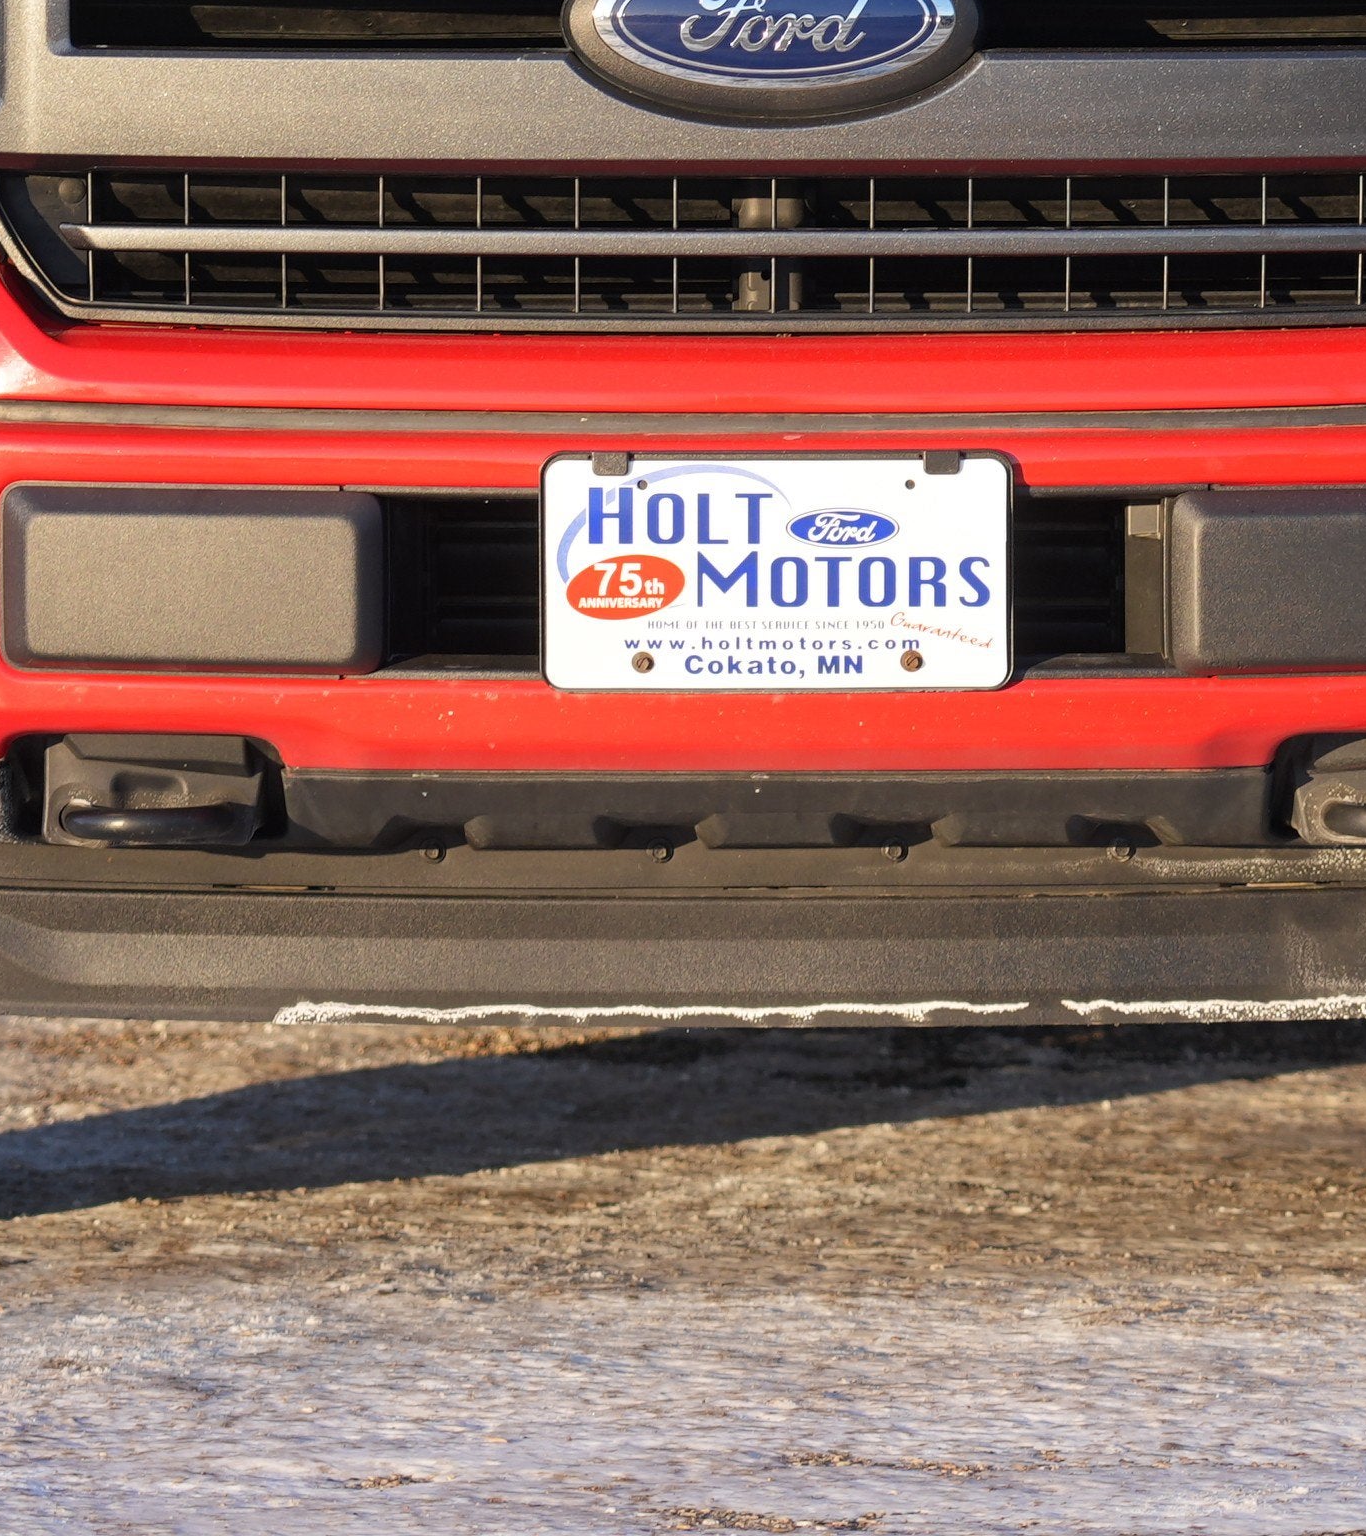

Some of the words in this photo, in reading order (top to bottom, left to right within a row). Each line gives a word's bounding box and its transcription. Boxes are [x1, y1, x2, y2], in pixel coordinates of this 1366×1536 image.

[808, 513, 878, 543] Ford
[594, 562, 665, 597] 75th
[578, 597, 663, 609] ANNIVERSARY
[648, 620, 680, 630] HOME
[686, 620, 698, 630] OF
[705, 620, 723, 630] THE
[730, 620, 756, 630] BEST
[762, 620, 809, 630] SERVICE
[815, 620, 849, 630] SINCE
[855, 620, 885, 630] 1950
[890, 611, 993, 649] Guaranteed
[624, 636, 920, 650] www.holtmotors.com
[685, 655, 805, 679] Cokato,
[817, 655, 863, 674] MN
